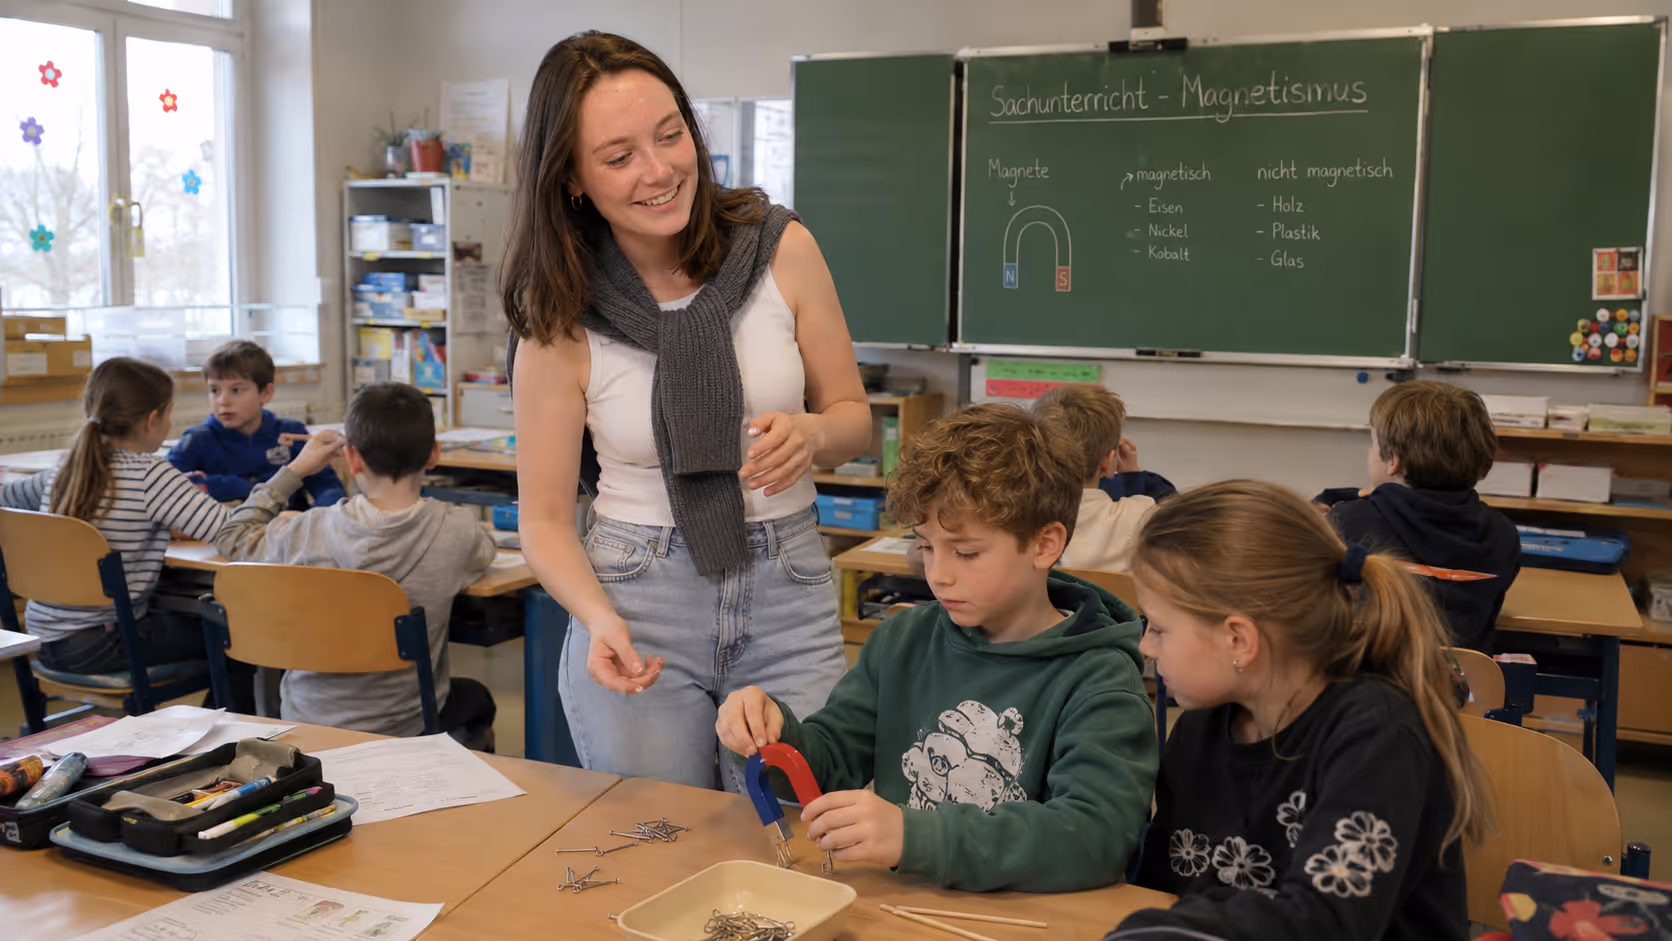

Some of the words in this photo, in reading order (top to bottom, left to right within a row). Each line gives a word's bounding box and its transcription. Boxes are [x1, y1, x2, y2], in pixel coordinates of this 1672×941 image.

[990, 78, 1149, 118] Sachunterricht
[1180, 71, 1369, 124] Magnetismus
[987, 157, 1050, 189] Magnete
[1136, 161, 1212, 190] magnetisch
[1257, 159, 1298, 180] nicht
[1307, 156, 1394, 188] magnetisch
[1148, 197, 1183, 214] Eisen
[1272, 194, 1305, 213] Holz
[1148, 222, 1189, 239] Nickel
[1272, 222, 1321, 241] Plastik
[1148, 245, 1190, 262] Kobalt
[1270, 248, 1305, 269] Glas
[1005, 269, 1015, 284] N
[1059, 271, 1068, 287] S
